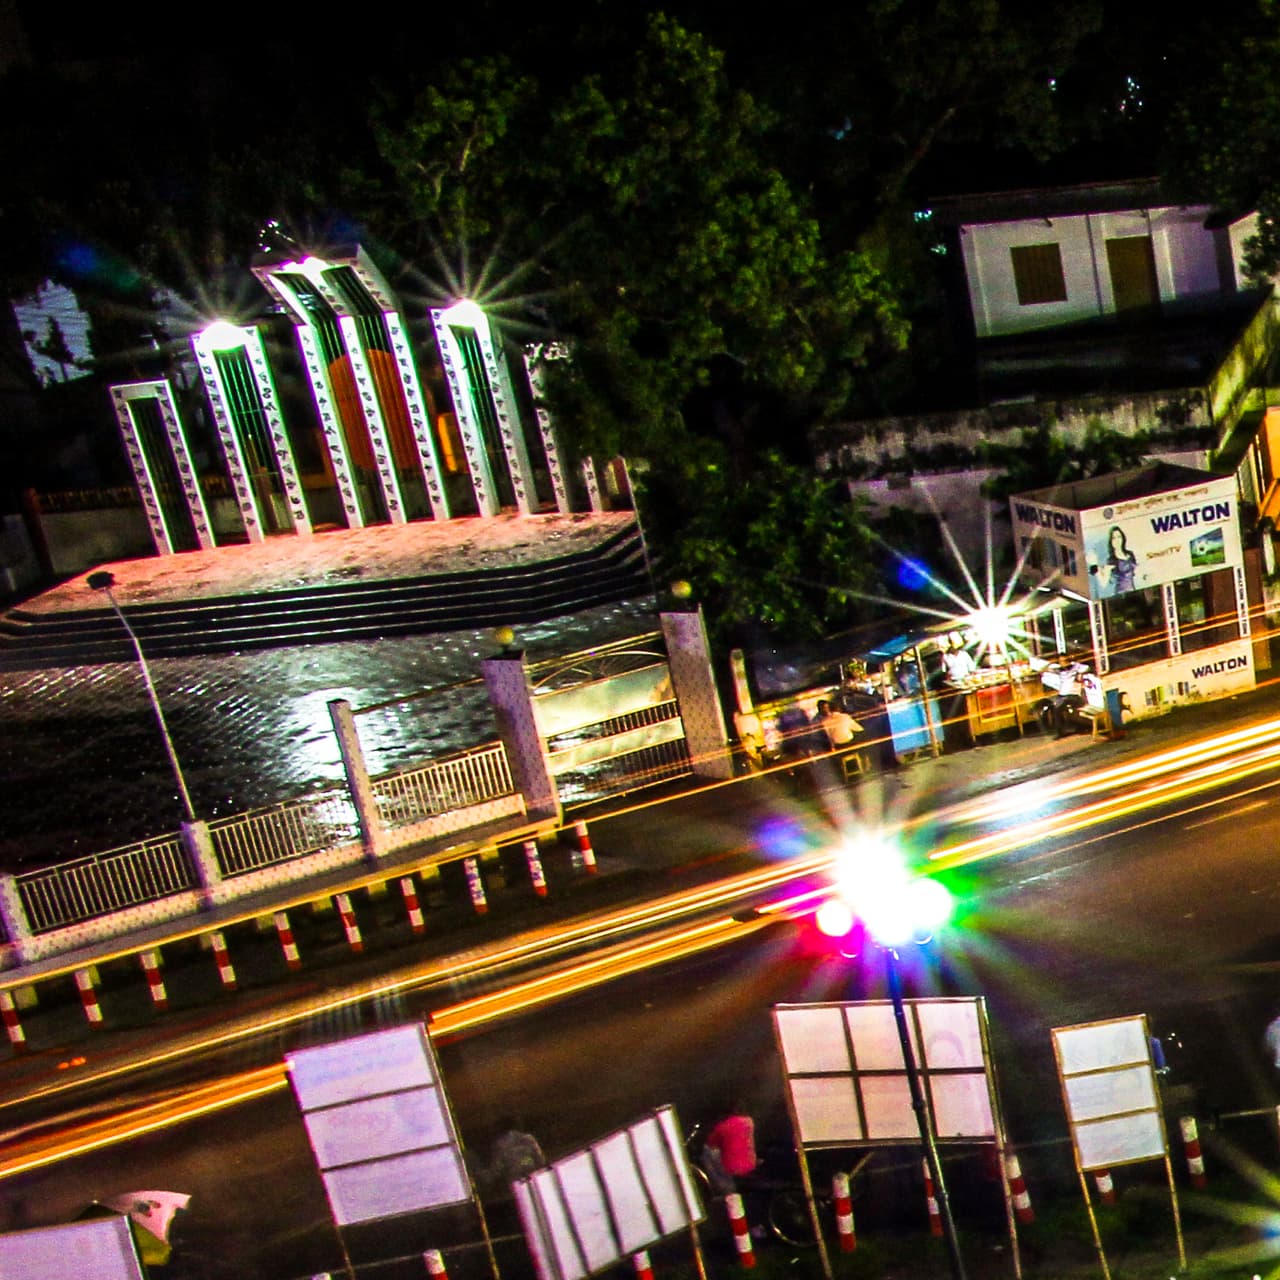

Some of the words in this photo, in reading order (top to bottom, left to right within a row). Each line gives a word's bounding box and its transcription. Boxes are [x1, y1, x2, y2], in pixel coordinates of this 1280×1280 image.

[1015, 503, 1076, 534] WALTON
[1151, 501, 1230, 534] WALTON
[1192, 655, 1247, 679] WALTON
